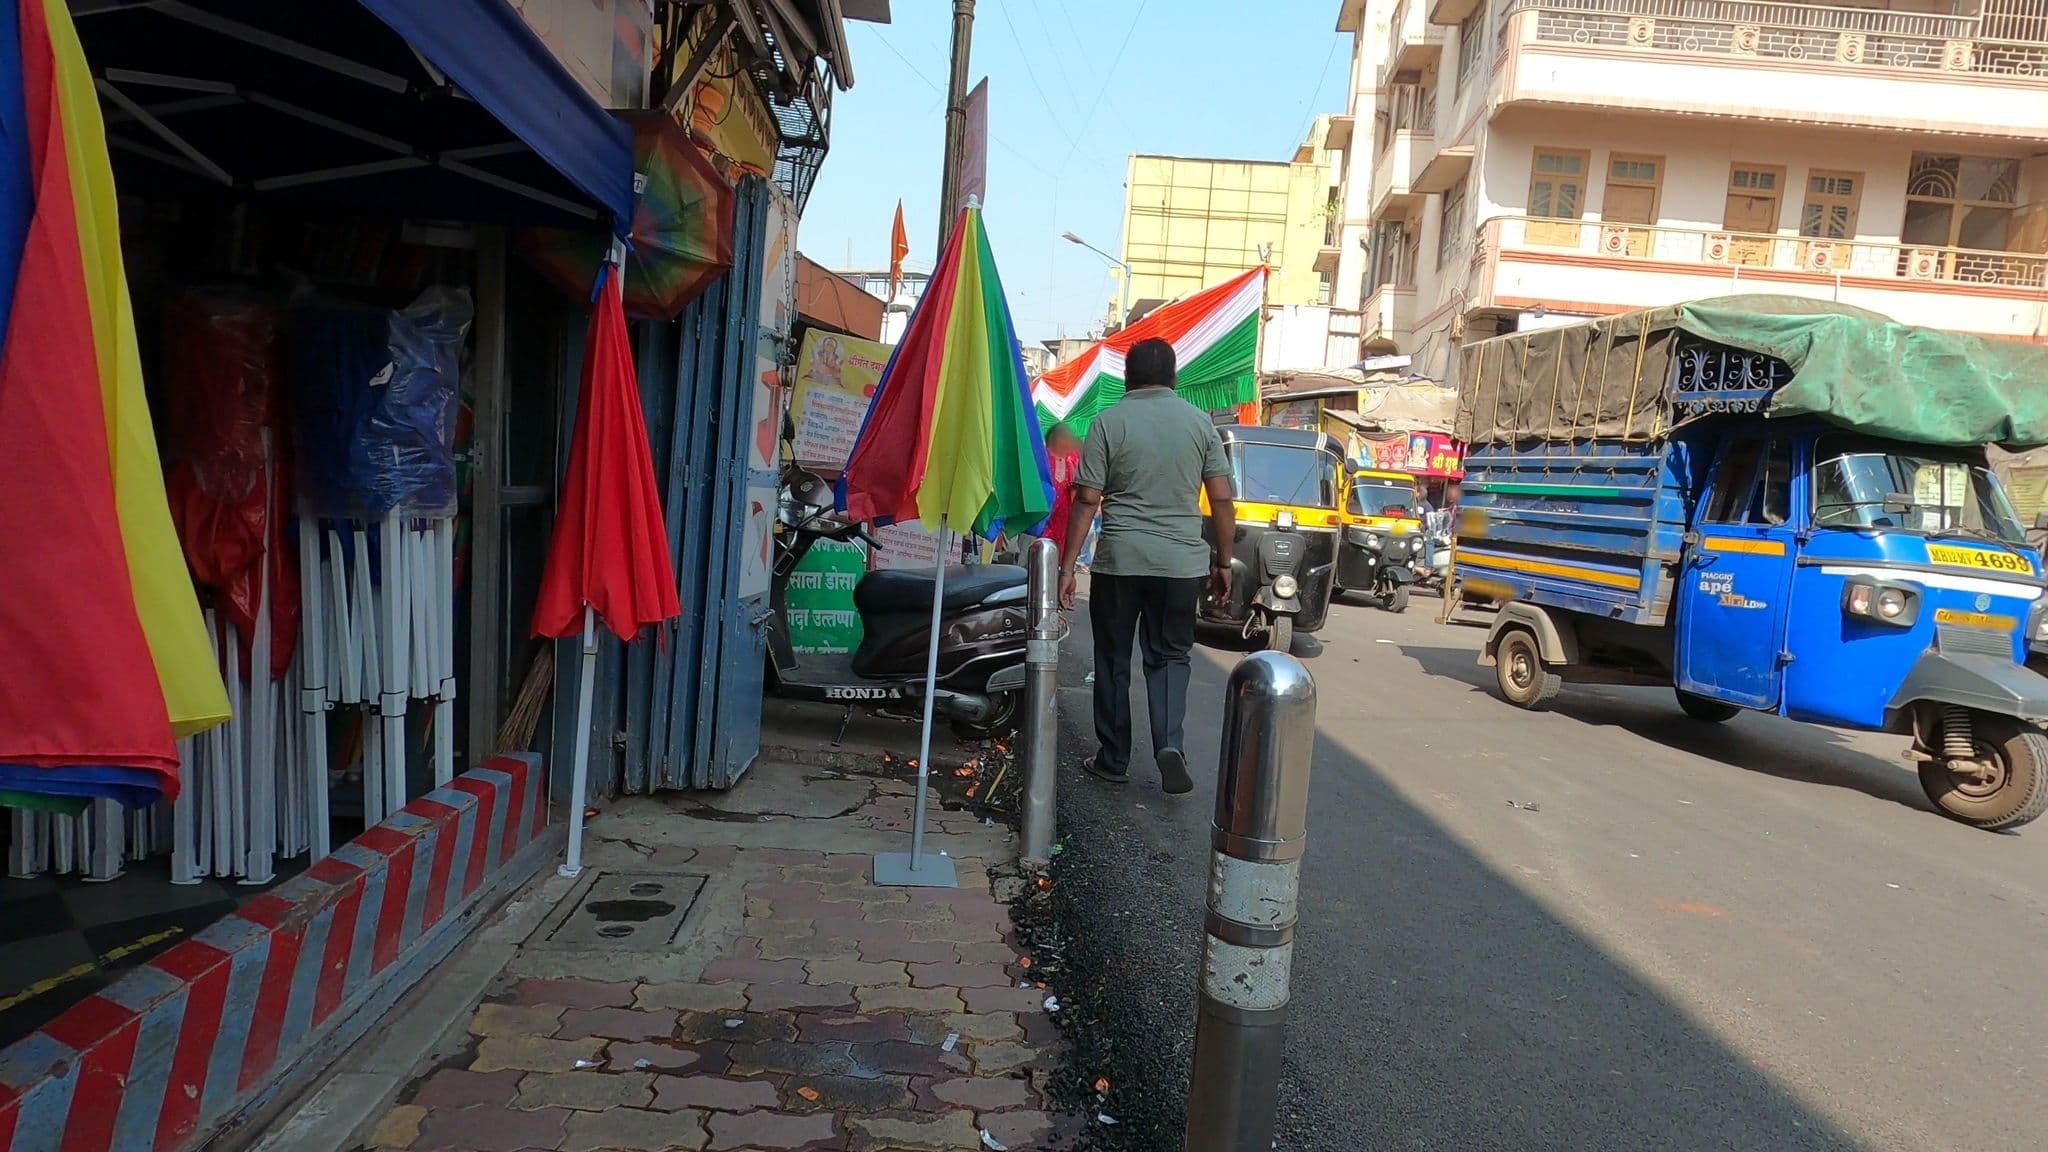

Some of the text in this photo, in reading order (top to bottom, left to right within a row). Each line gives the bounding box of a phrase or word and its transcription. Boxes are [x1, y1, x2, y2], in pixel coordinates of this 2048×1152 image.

[1974, 552, 2030, 572] 4699
[787, 566, 856, 591] साला डोसा
[1701, 572, 1733, 581] PIAGGIO
[826, 688, 901, 699] HONDA
